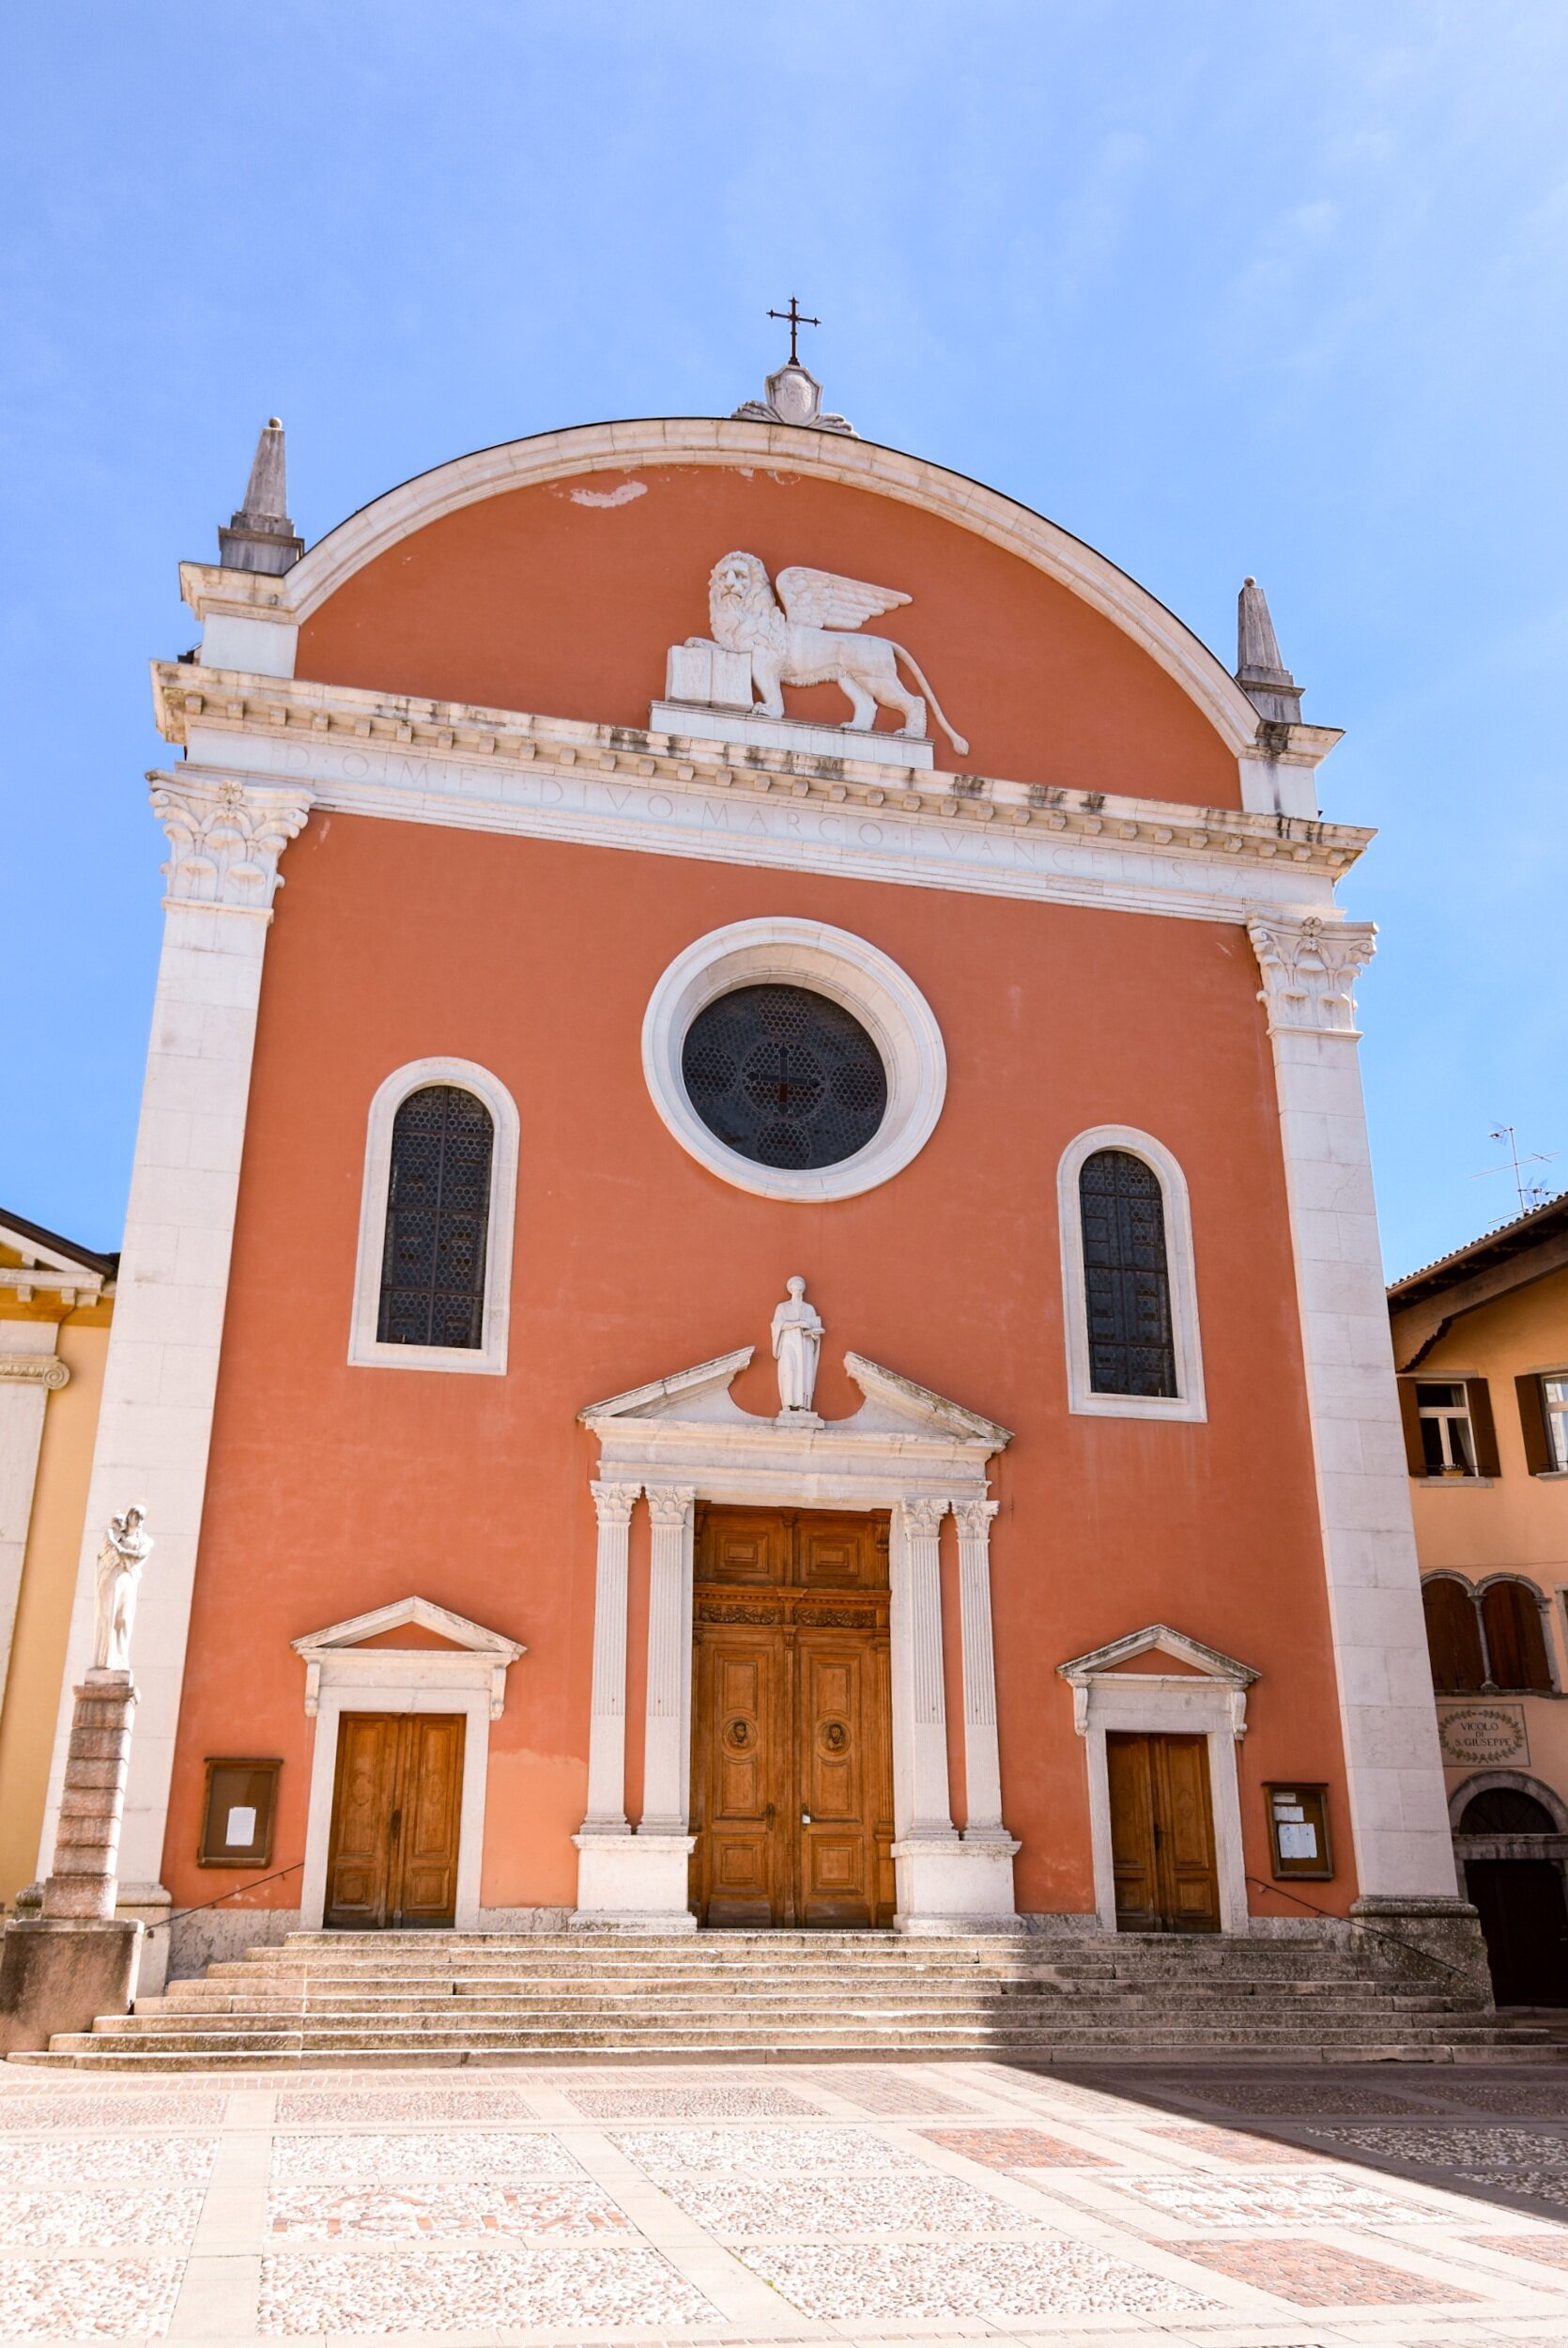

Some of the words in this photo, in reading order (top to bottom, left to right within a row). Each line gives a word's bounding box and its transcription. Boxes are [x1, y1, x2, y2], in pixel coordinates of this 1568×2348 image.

[1460, 1722, 1499, 1731] VICOLO
[1455, 1738, 1463, 1747] S.
[1464, 1738, 1512, 1747] GIUSEPPE
